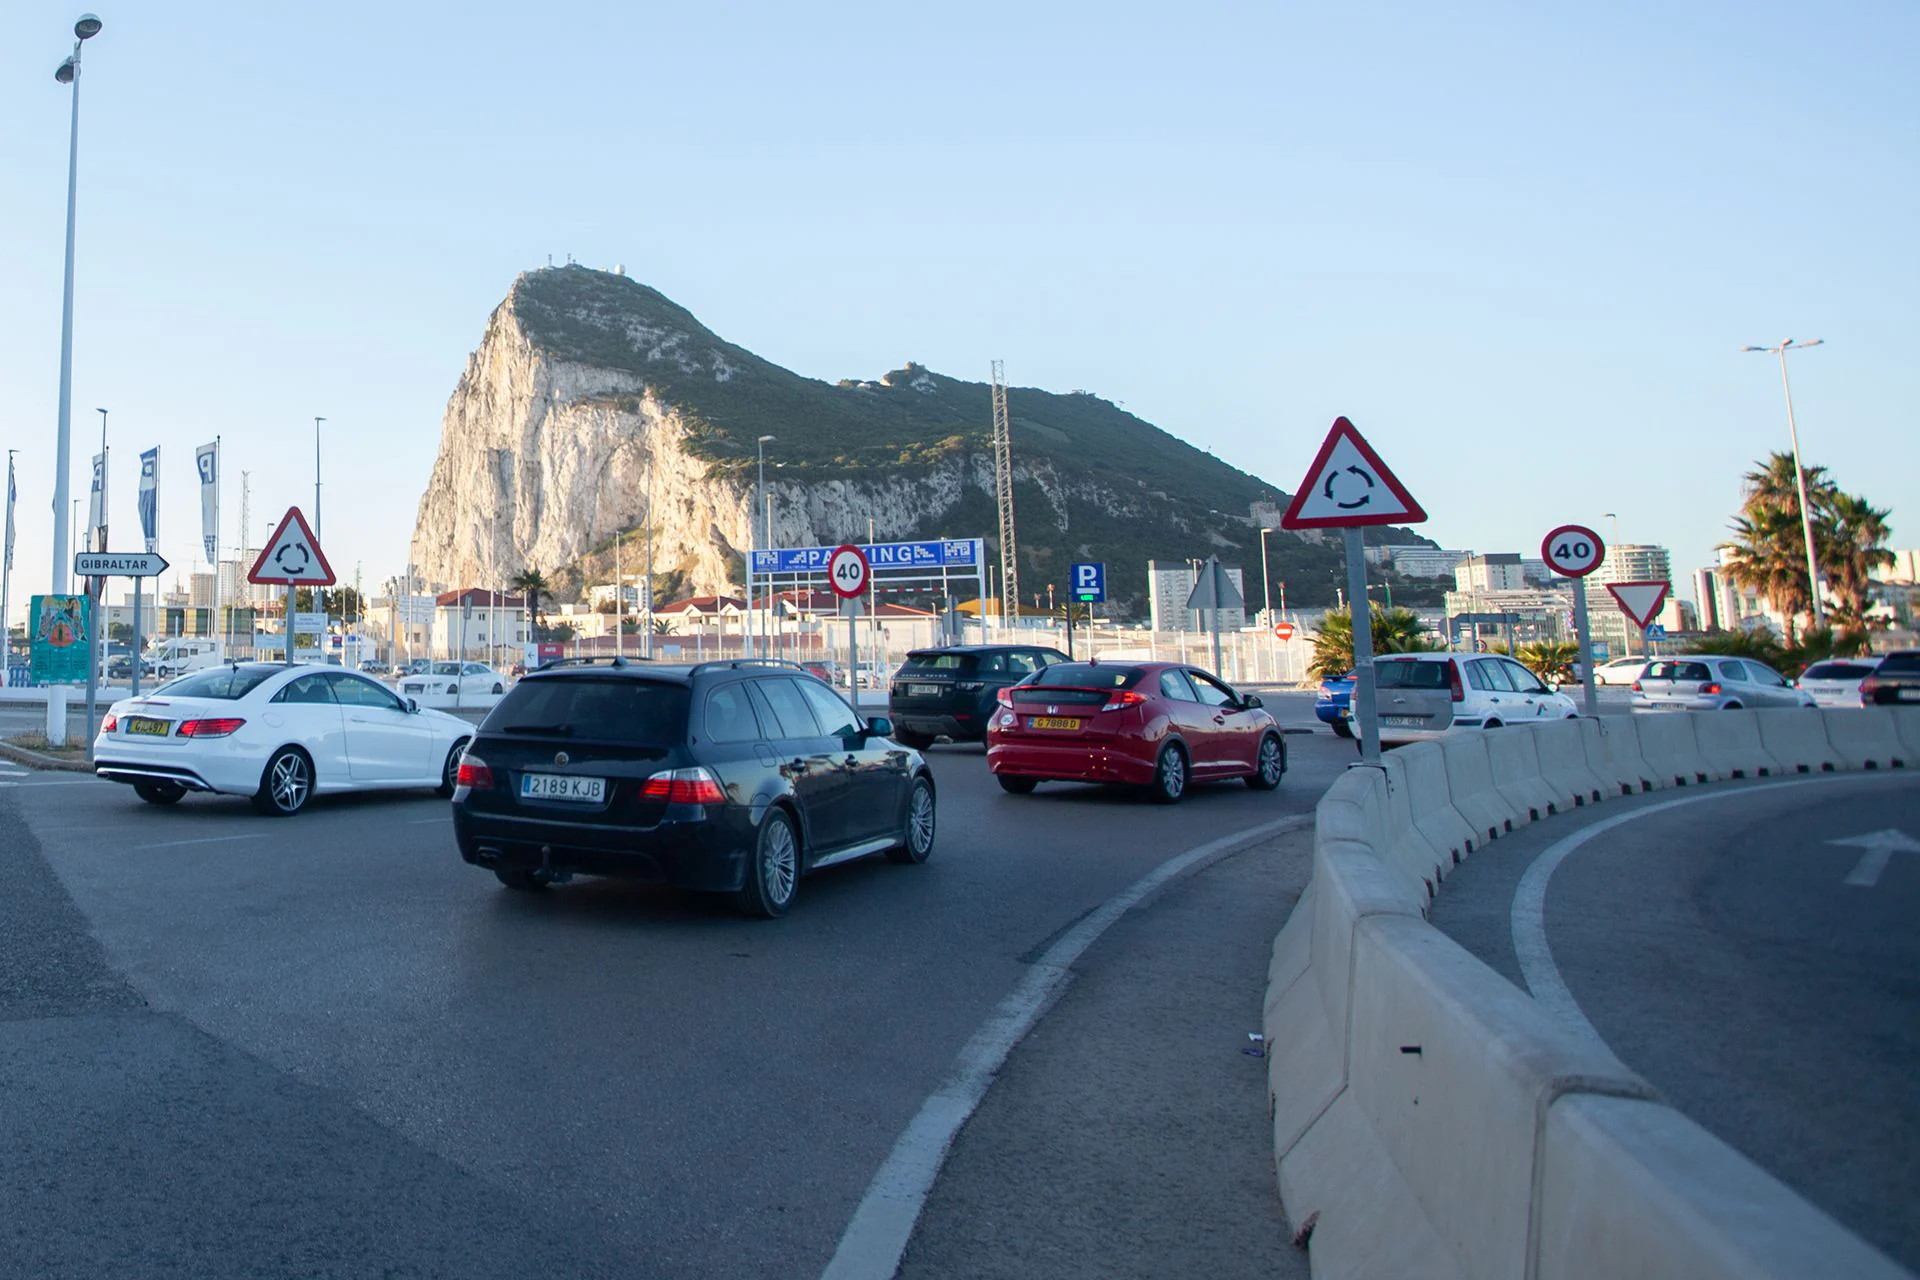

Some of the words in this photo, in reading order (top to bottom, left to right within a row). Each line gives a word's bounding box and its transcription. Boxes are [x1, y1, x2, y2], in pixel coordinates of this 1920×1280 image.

[809, 546, 912, 566] PAING
[1554, 542, 1590, 559] 40
[81, 559, 148, 570] GIBRALTAR
[836, 562, 860, 580] 40
[1078, 565, 1097, 587] P
[532, 778, 568, 794] 2189
[572, 780, 601, 797] KJB
